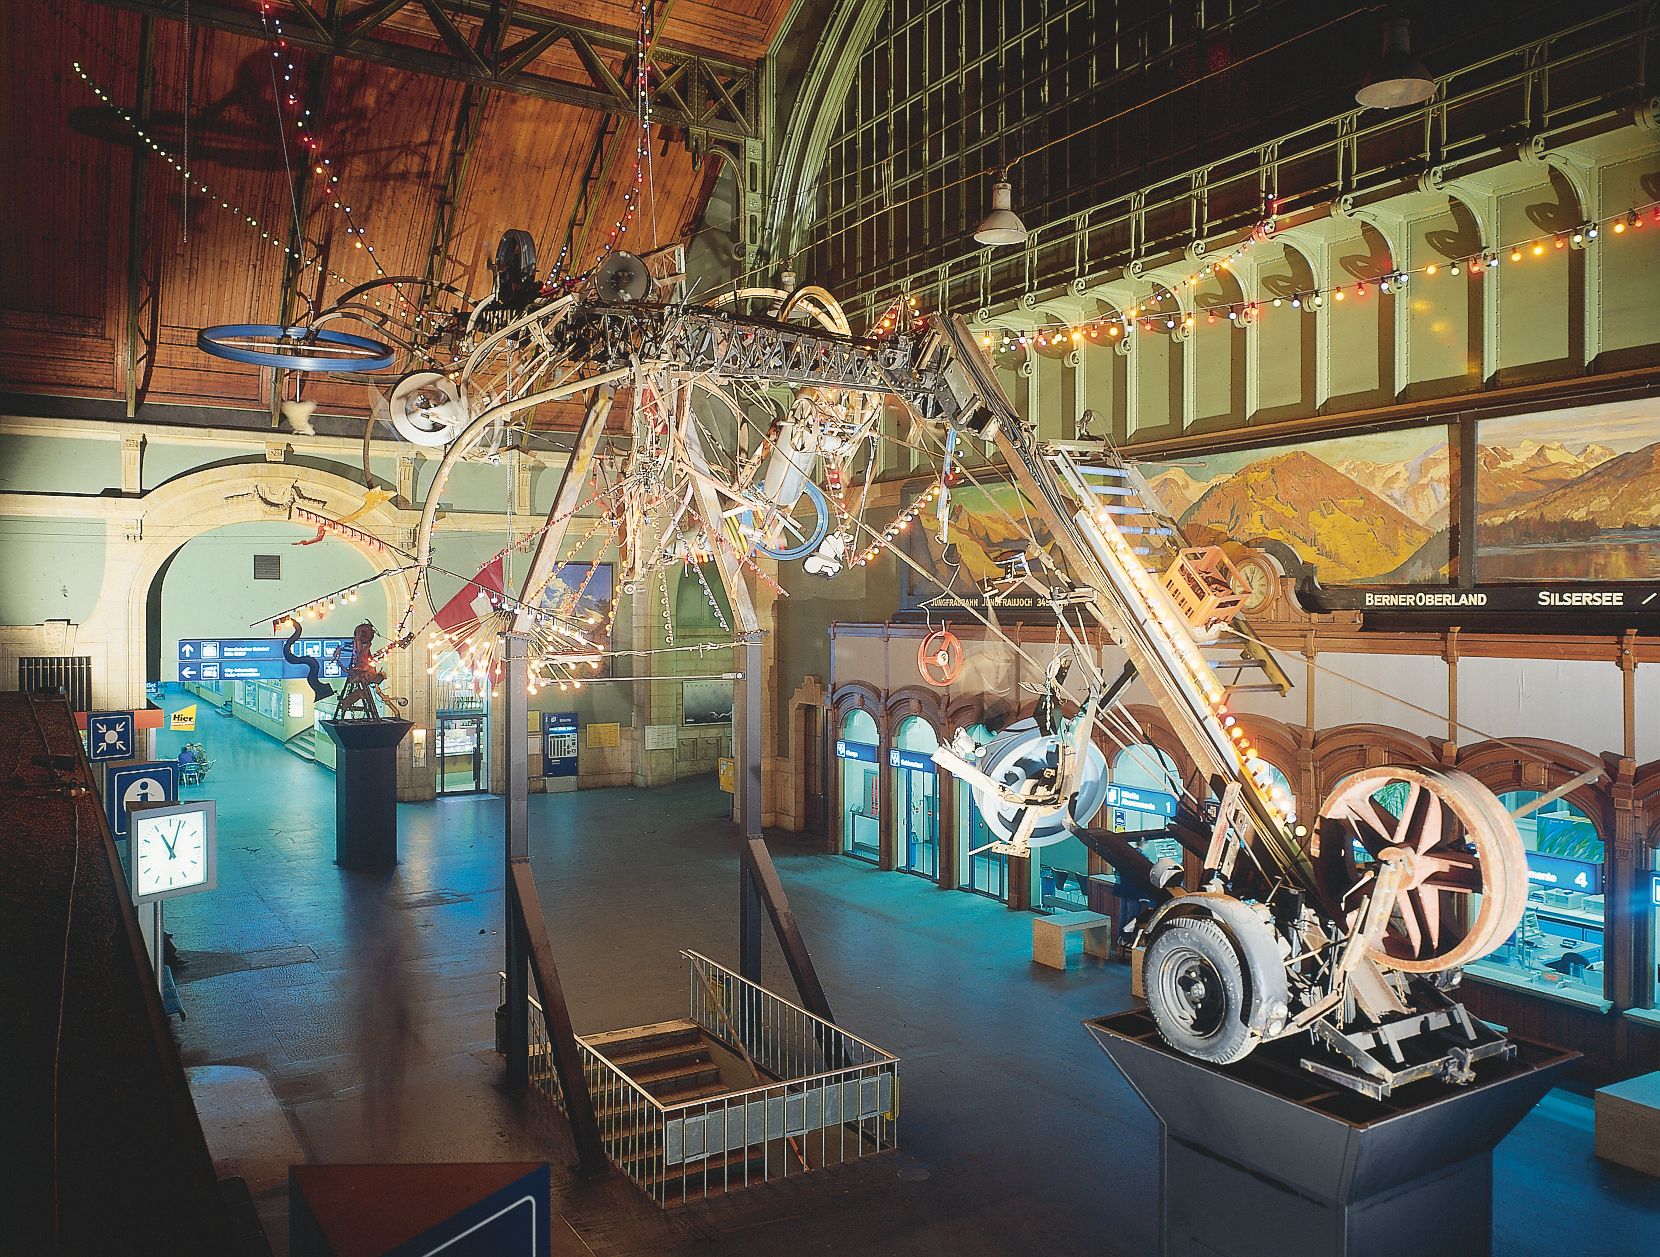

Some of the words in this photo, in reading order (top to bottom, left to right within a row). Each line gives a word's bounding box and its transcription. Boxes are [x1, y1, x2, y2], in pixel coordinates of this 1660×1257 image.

[1537, 591, 1624, 606] SILSERSEE
[1165, 801, 1171, 814] 1
[1574, 871, 1588, 888] 4
